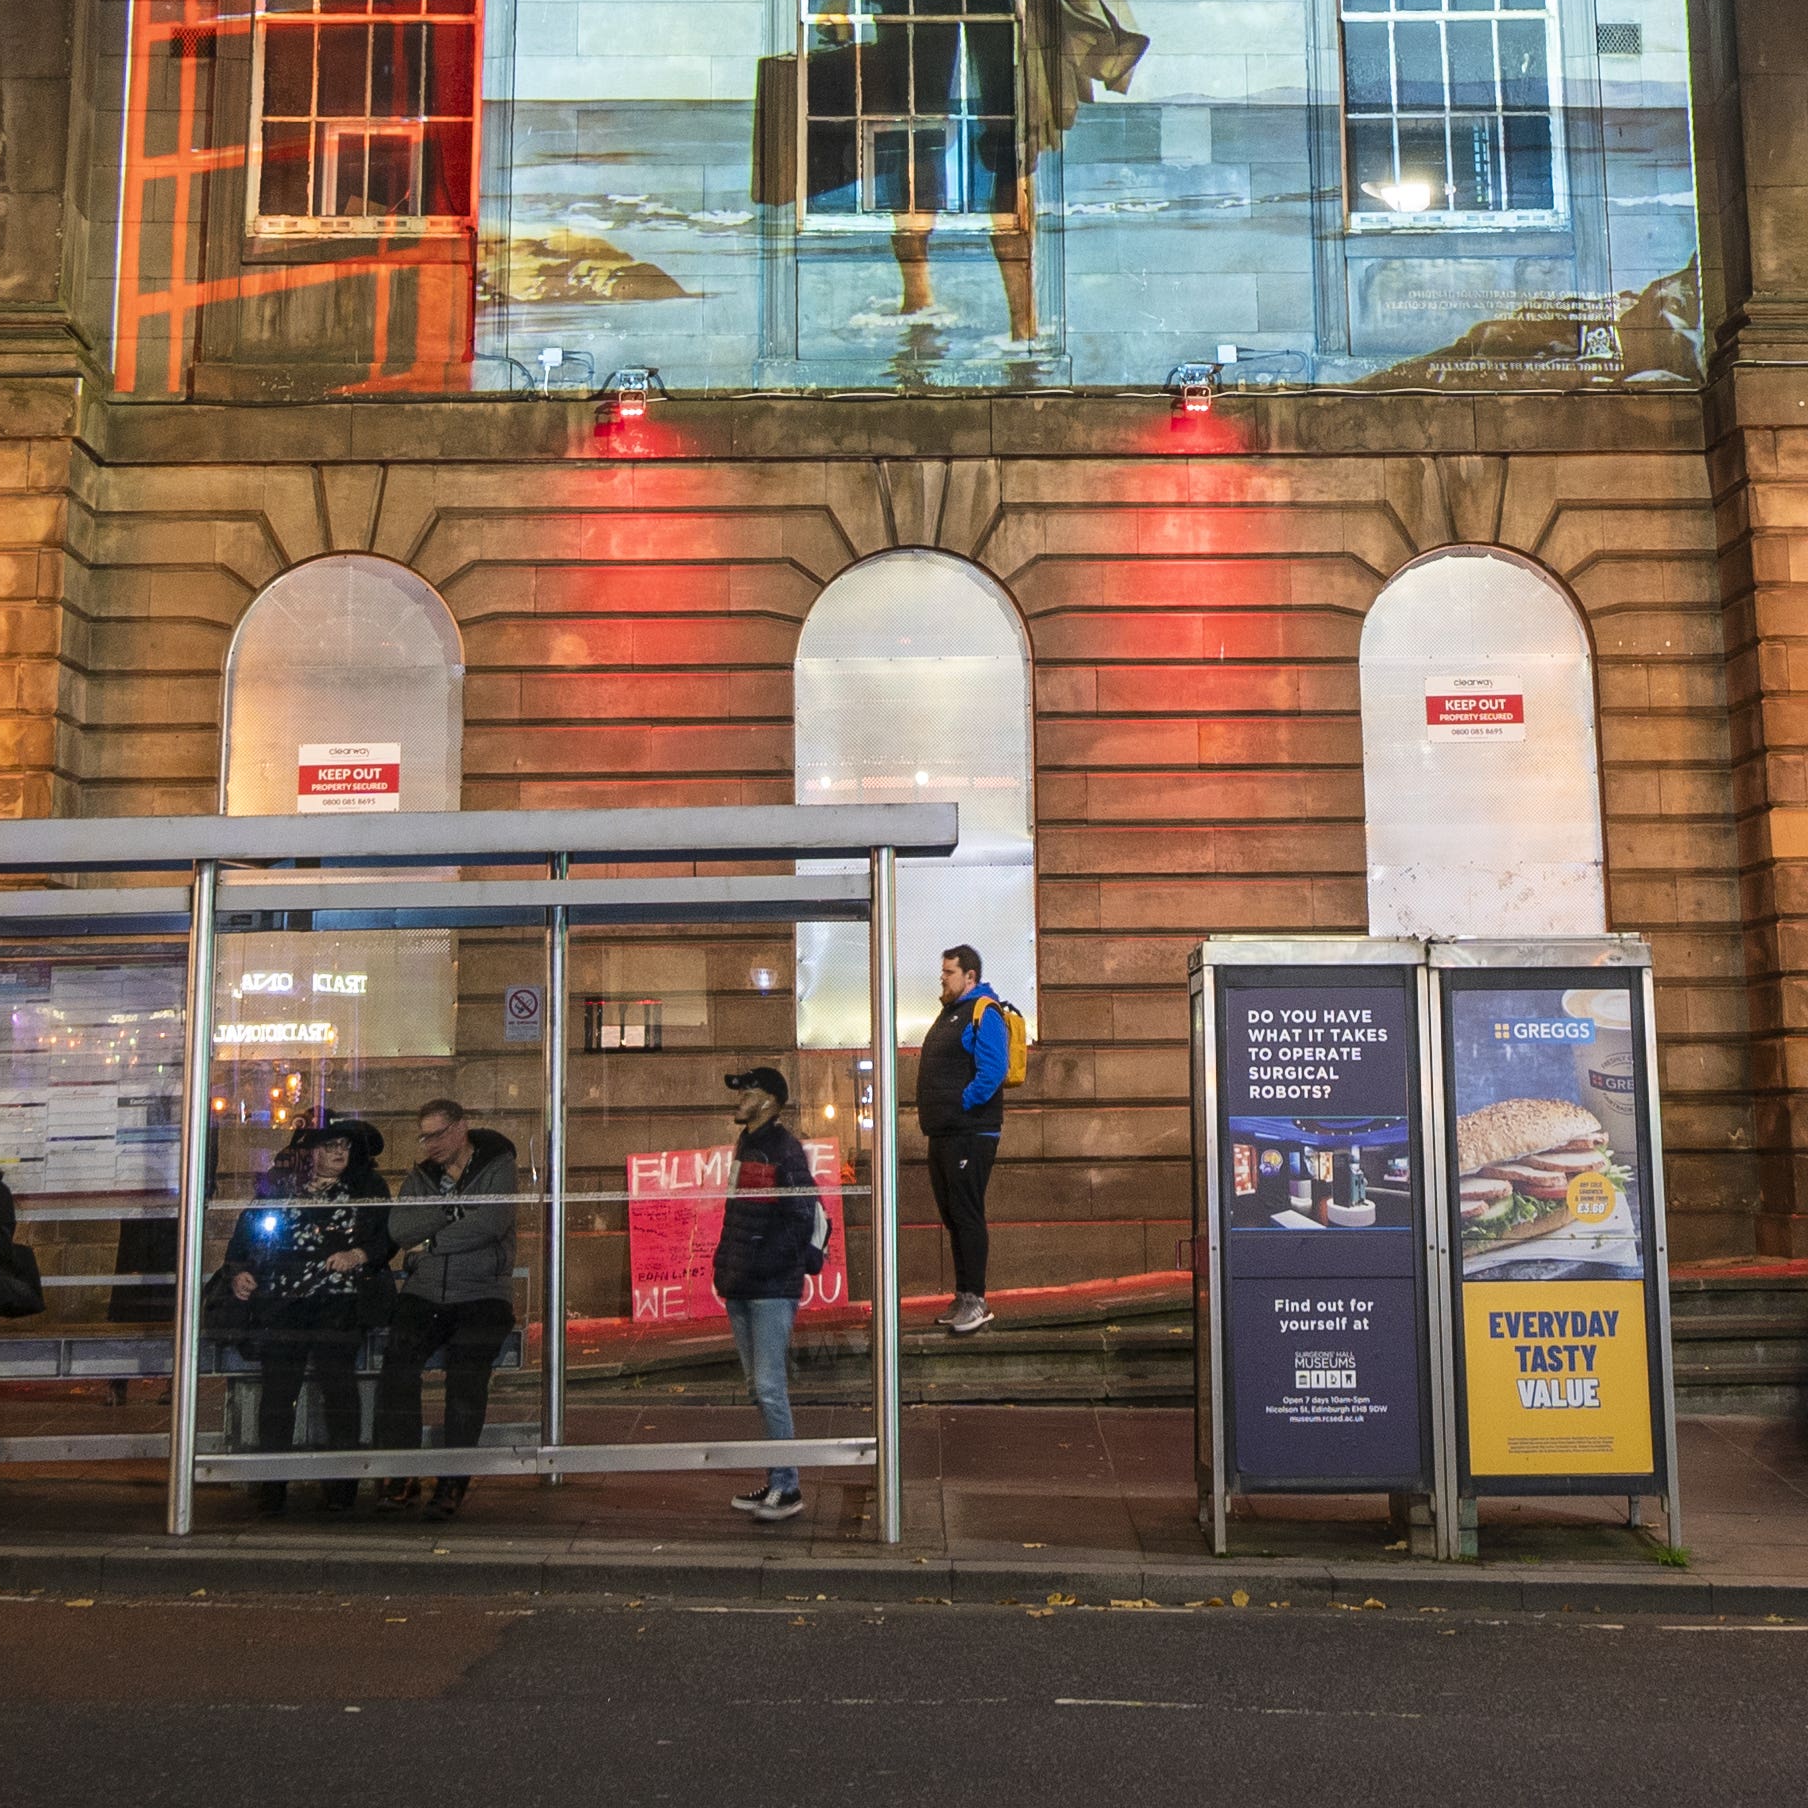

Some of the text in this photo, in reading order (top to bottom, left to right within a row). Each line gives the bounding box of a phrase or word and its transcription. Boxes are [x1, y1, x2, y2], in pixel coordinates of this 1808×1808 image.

[1454, 678, 1494, 688] clearway
[1445, 698, 1507, 711] KEEP OUT
[1439, 713, 1514, 721] PROPERTY SECURED
[328, 747, 370, 757] clearway
[318, 767, 382, 781] KEEP OUT
[311, 782, 388, 791] PROPERTY SECURED
[1248, 1010, 1372, 1023] DO YOU HAVE
[1248, 1029, 1388, 1042] WHAT IT TAKES
[1513, 1023, 1591, 1038] GREGGS
[1248, 1047, 1362, 1061] TO OPERATE
[1249, 1066, 1339, 1080] SURGICAL
[1249, 1085, 1332, 1099] ROBOTS?
[634, 1285, 686, 1320] WE
[1274, 1298, 1374, 1312] Find out for
[1280, 1317, 1369, 1333] yourself at
[1489, 1311, 1619, 1338] EVERYDAY
[1295, 1357, 1356, 1369] MUSEUMS
[1515, 1345, 1597, 1372] TASTY
[1517, 1378, 1600, 1409] VALUE
[1282, 1396, 1304, 1405] Open
[1312, 1396, 1329, 1405] days
[1331, 1396, 1371, 1405] 10am-5pm
[1266, 1406, 1299, 1414] Nicolson
[1312, 1405, 1350, 1415] Edinburgh
[1289, 1414, 1364, 1423] museum.rcsed.ac.uk
